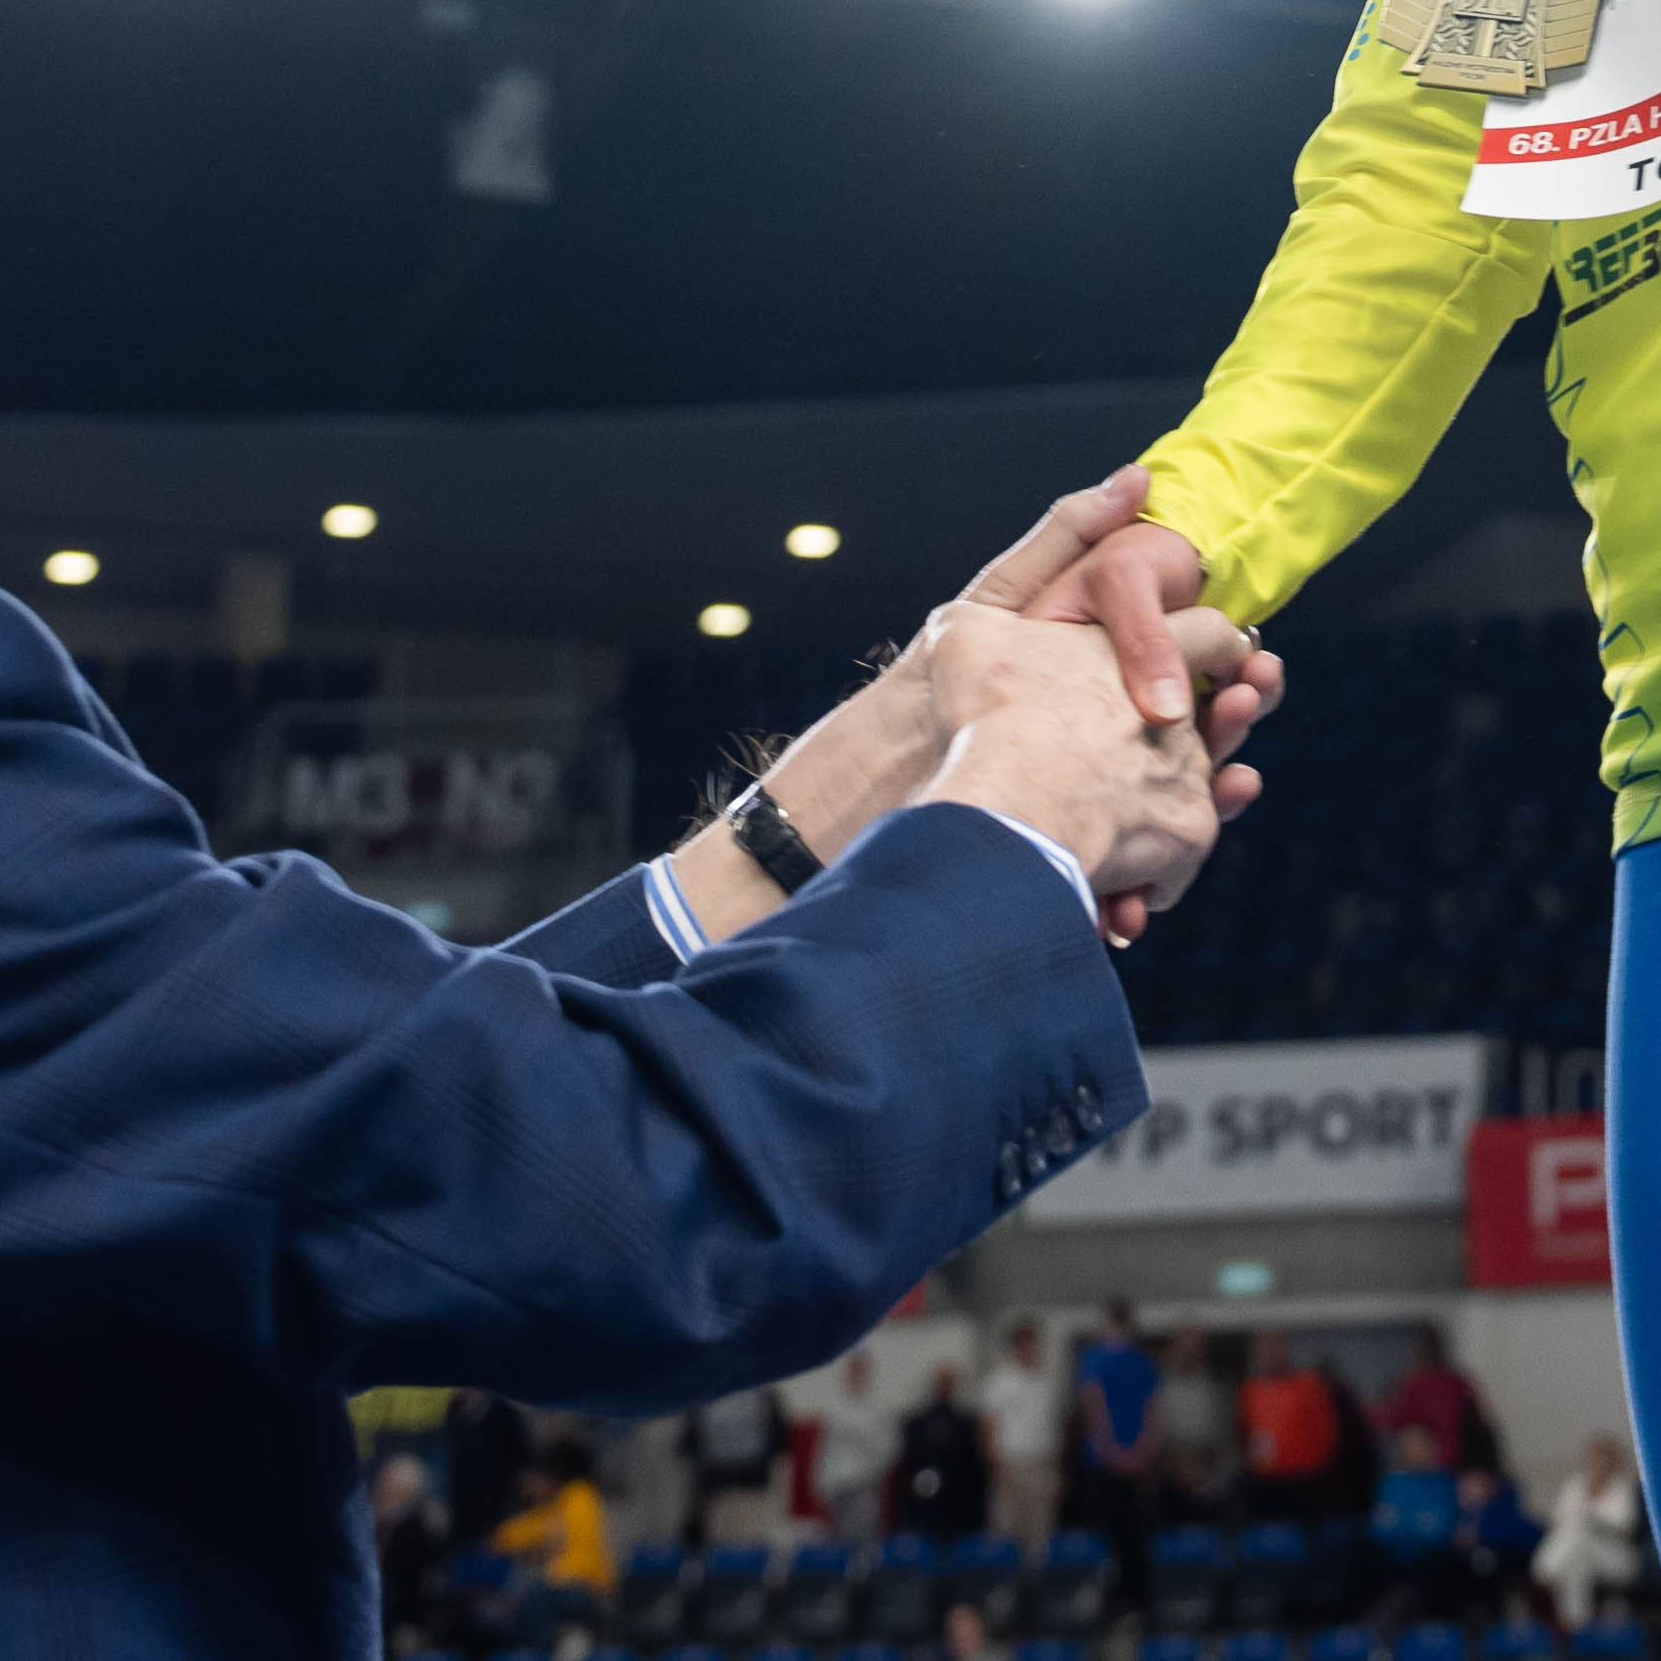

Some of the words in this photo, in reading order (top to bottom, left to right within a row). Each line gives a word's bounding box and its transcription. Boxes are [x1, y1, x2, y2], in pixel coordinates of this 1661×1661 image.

[1507, 130, 1561, 155] 68.
[1568, 113, 1643, 150] PZLA
[1207, 1085, 1461, 1165] SPORT
